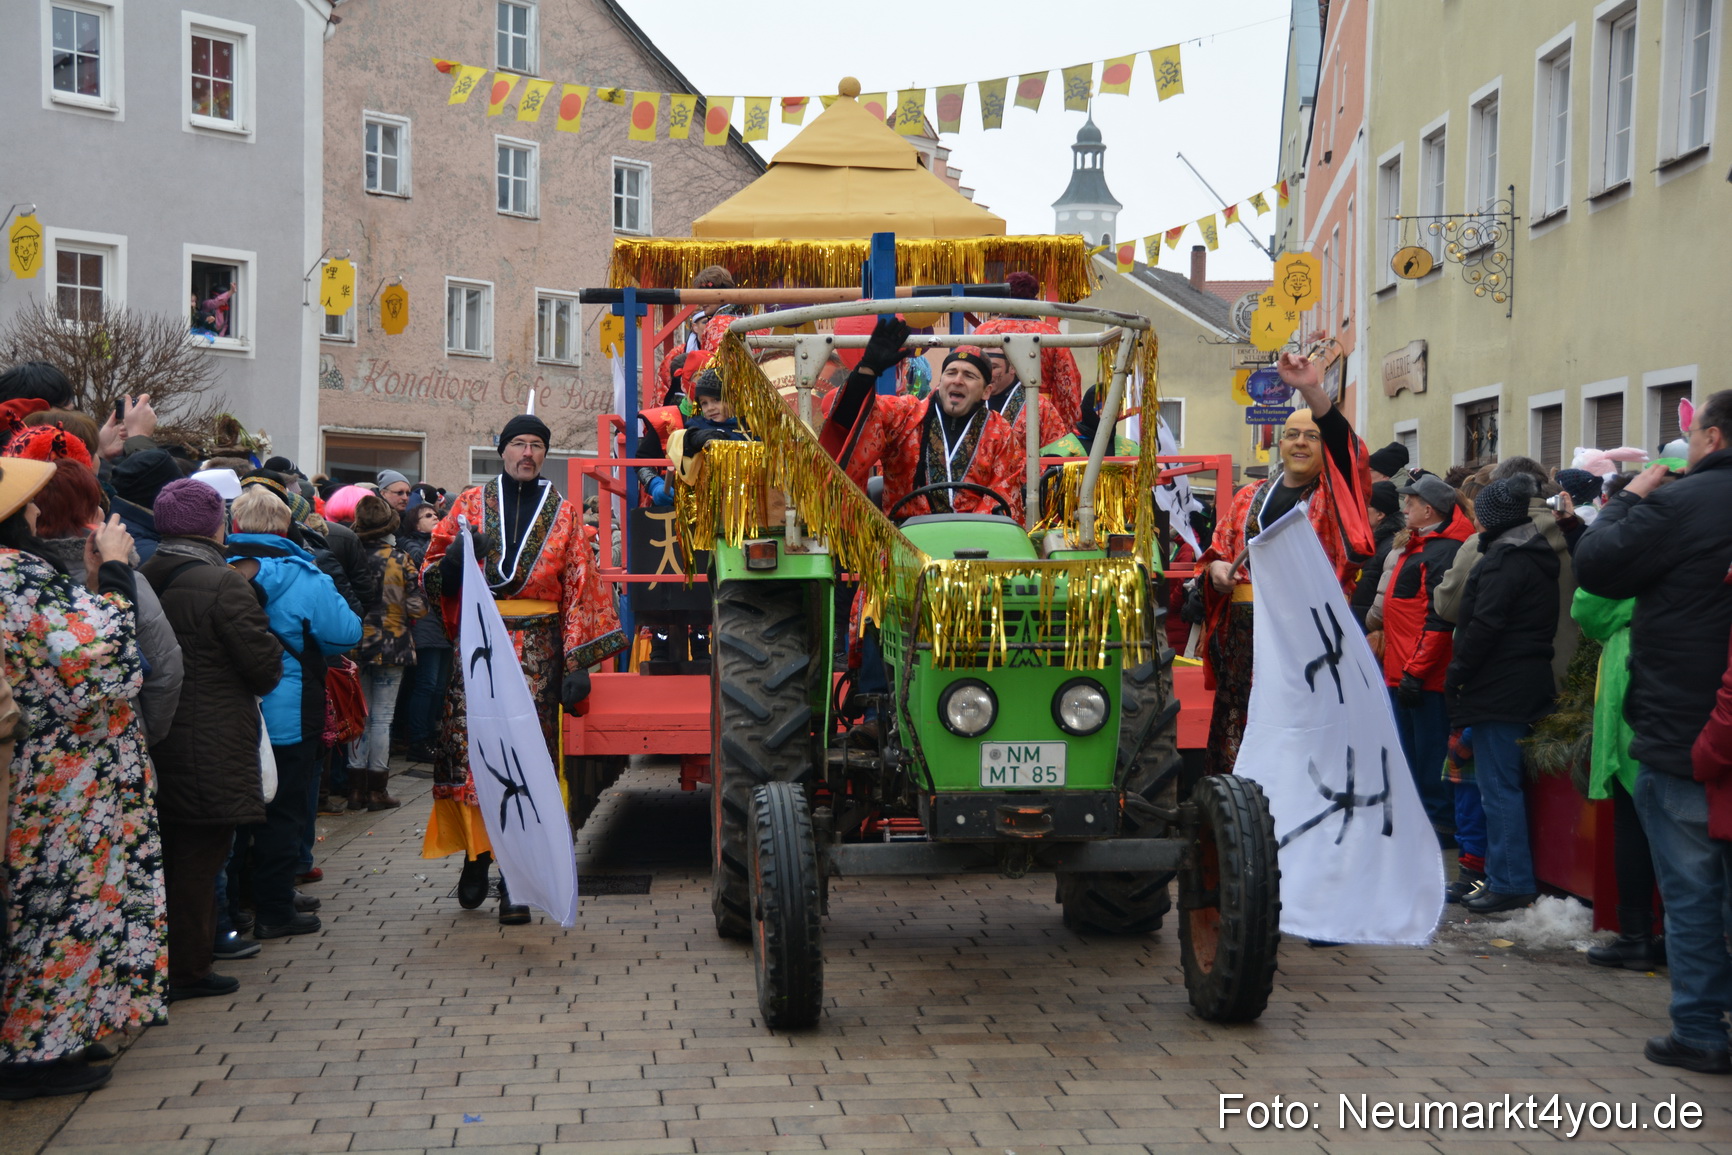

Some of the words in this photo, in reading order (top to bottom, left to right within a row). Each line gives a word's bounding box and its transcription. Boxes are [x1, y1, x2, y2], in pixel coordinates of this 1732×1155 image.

[357, 357, 490, 402] Konditorei
[1385, 354, 1411, 382] GALERIE
[1007, 746, 1040, 763] NM
[989, 766, 1020, 784] MT
[1032, 766, 1058, 783] 85
